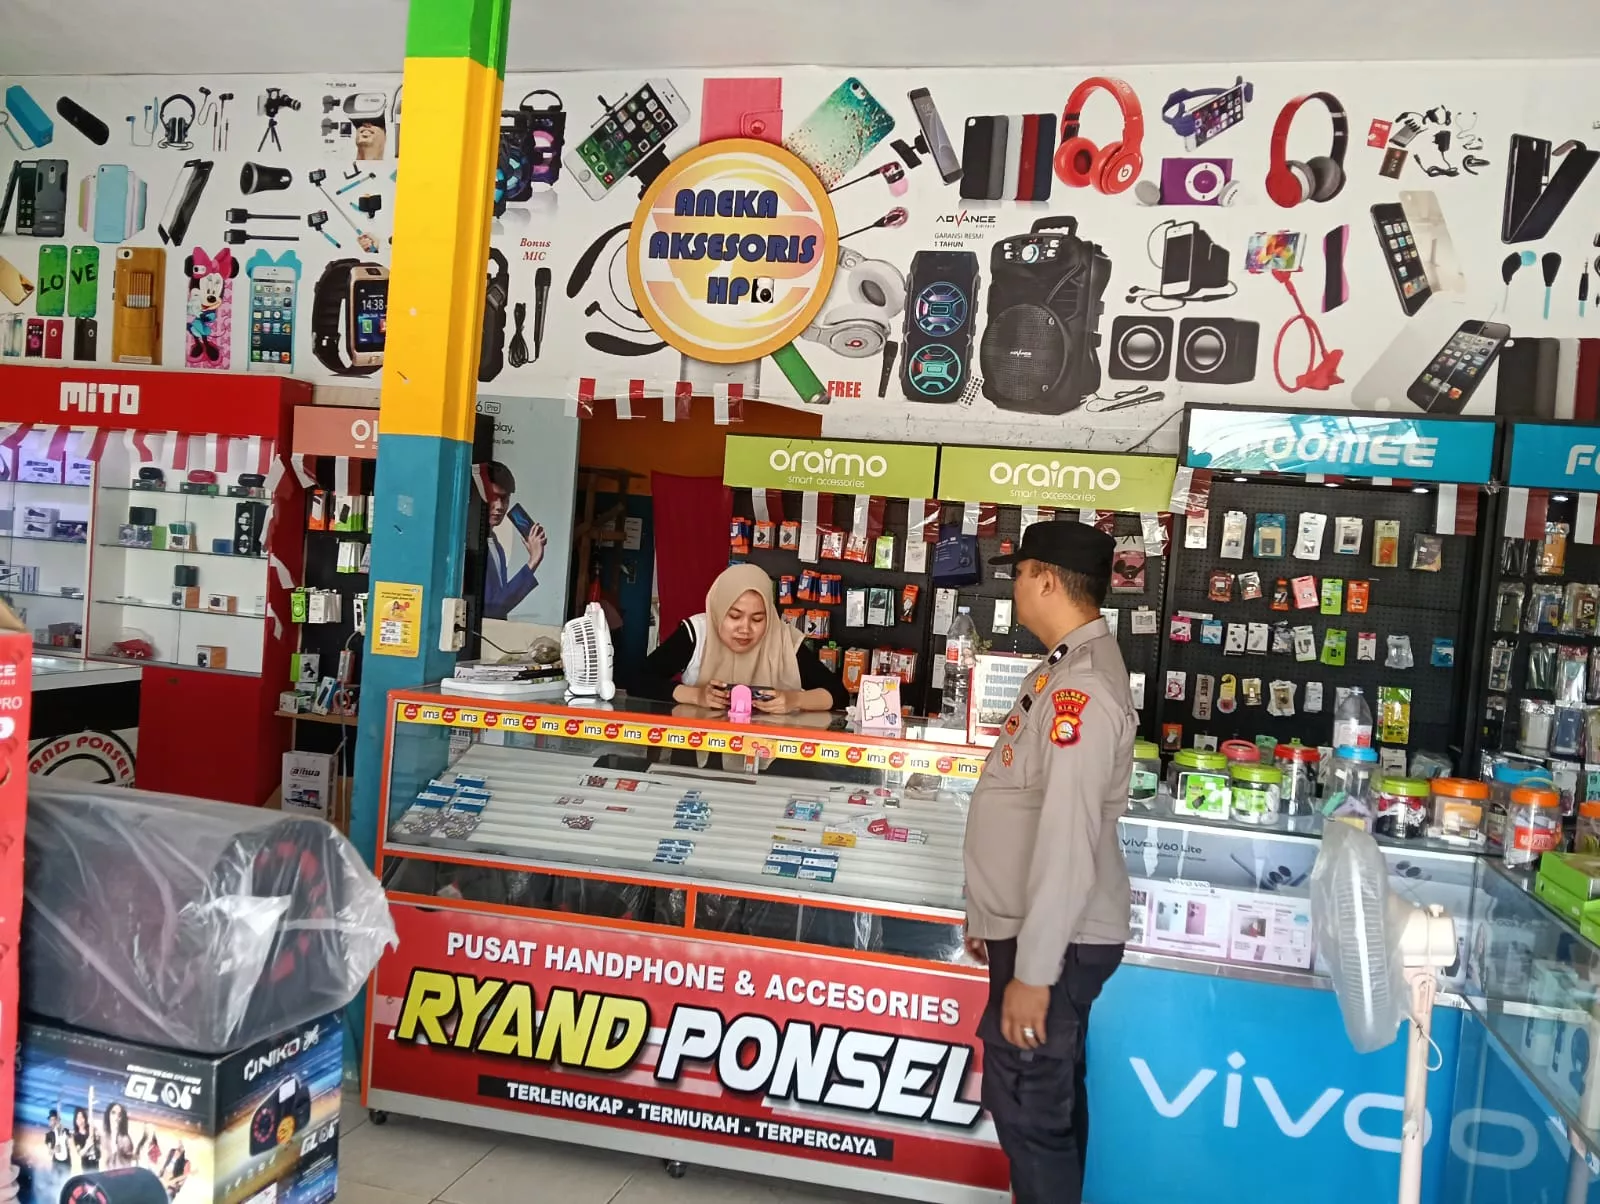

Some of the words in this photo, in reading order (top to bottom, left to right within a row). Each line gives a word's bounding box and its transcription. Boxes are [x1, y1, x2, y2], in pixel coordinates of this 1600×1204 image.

[674, 188, 778, 218] ANEKA
[936, 210, 996, 228] ADVANCE
[520, 237, 552, 248] Bonus
[648, 231, 817, 264] AKSESORIS
[934, 232, 963, 240] GARANSI
[964, 232, 984, 240] RESMI
[522, 251, 547, 261] MIC
[706, 276, 750, 305] HP
[828, 380, 862, 398] FREE
[486, 404, 499, 412] Pro
[769, 448, 888, 478] oraimo
[1238, 429, 1440, 468] OOMEE
[788, 475, 813, 484] smart
[816, 478, 865, 488] accessories
[990, 460, 1121, 491] oraimo
[1010, 489, 1038, 498] smart
[1041, 490, 1096, 502] accessories
[423, 710, 440, 720] im3
[461, 713, 478, 722] im3
[503, 717, 520, 726] im3
[542, 721, 559, 730] im3
[584, 725, 602, 735] im3
[624, 728, 642, 739] im3
[668, 733, 686, 744] im3
[708, 737, 726, 748] im3
[779, 744, 798, 754] im3
[821, 748, 840, 758] im3
[867, 754, 886, 764] im3
[958, 763, 978, 774] im3
[1122, 838, 1153, 848] vivo
[1156, 842, 1179, 852] V60
[1180, 844, 1203, 854] Lite
[446, 932, 538, 966] PUSAT
[544, 944, 726, 993] HANDPHONE
[734, 968, 756, 997] &
[764, 974, 961, 1026] ACCESORIES
[396, 968, 650, 1071] RYAND
[655, 1005, 983, 1127] PONSEL
[124, 1074, 160, 1104] GL
[1128, 1051, 1433, 1153] vivo
[506, 1082, 624, 1116] TERLENGKAP
[639, 1103, 740, 1135] TERMURAH
[756, 1122, 877, 1158] TERPERCAYA
